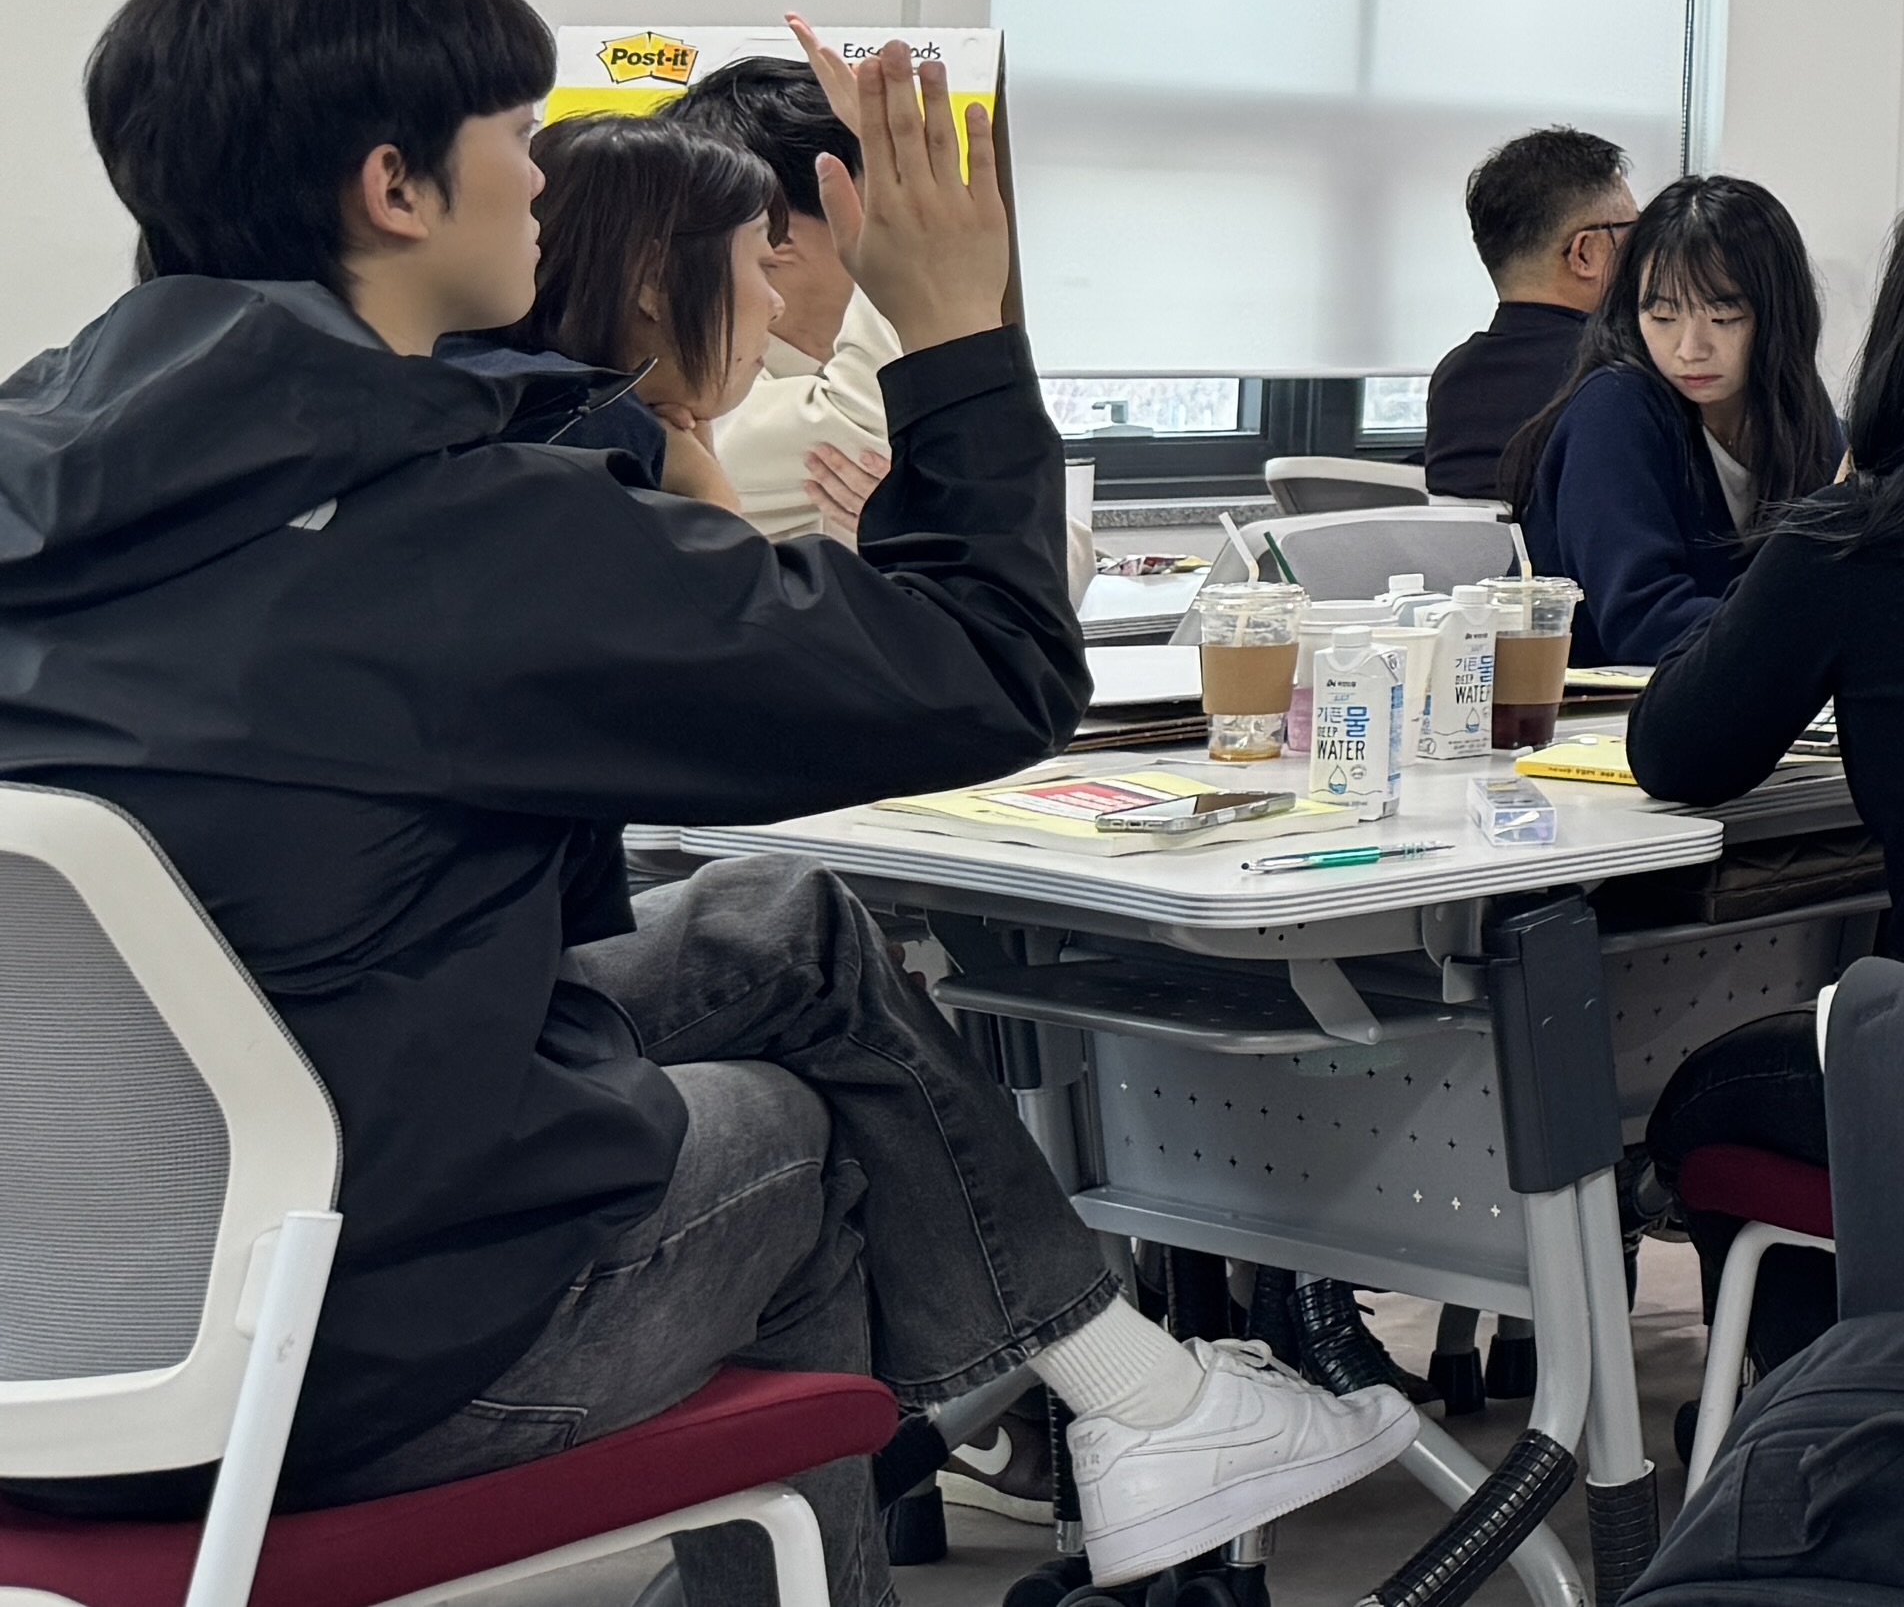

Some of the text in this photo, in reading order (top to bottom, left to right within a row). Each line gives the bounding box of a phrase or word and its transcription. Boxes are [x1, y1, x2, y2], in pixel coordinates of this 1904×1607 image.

[610, 48, 689, 67] Post-it
[910, 41, 942, 60] ads
[1343, 705, 1370, 738] 물
[1316, 725, 1338, 738] DEEP
[1316, 739, 1366, 761] WATER
